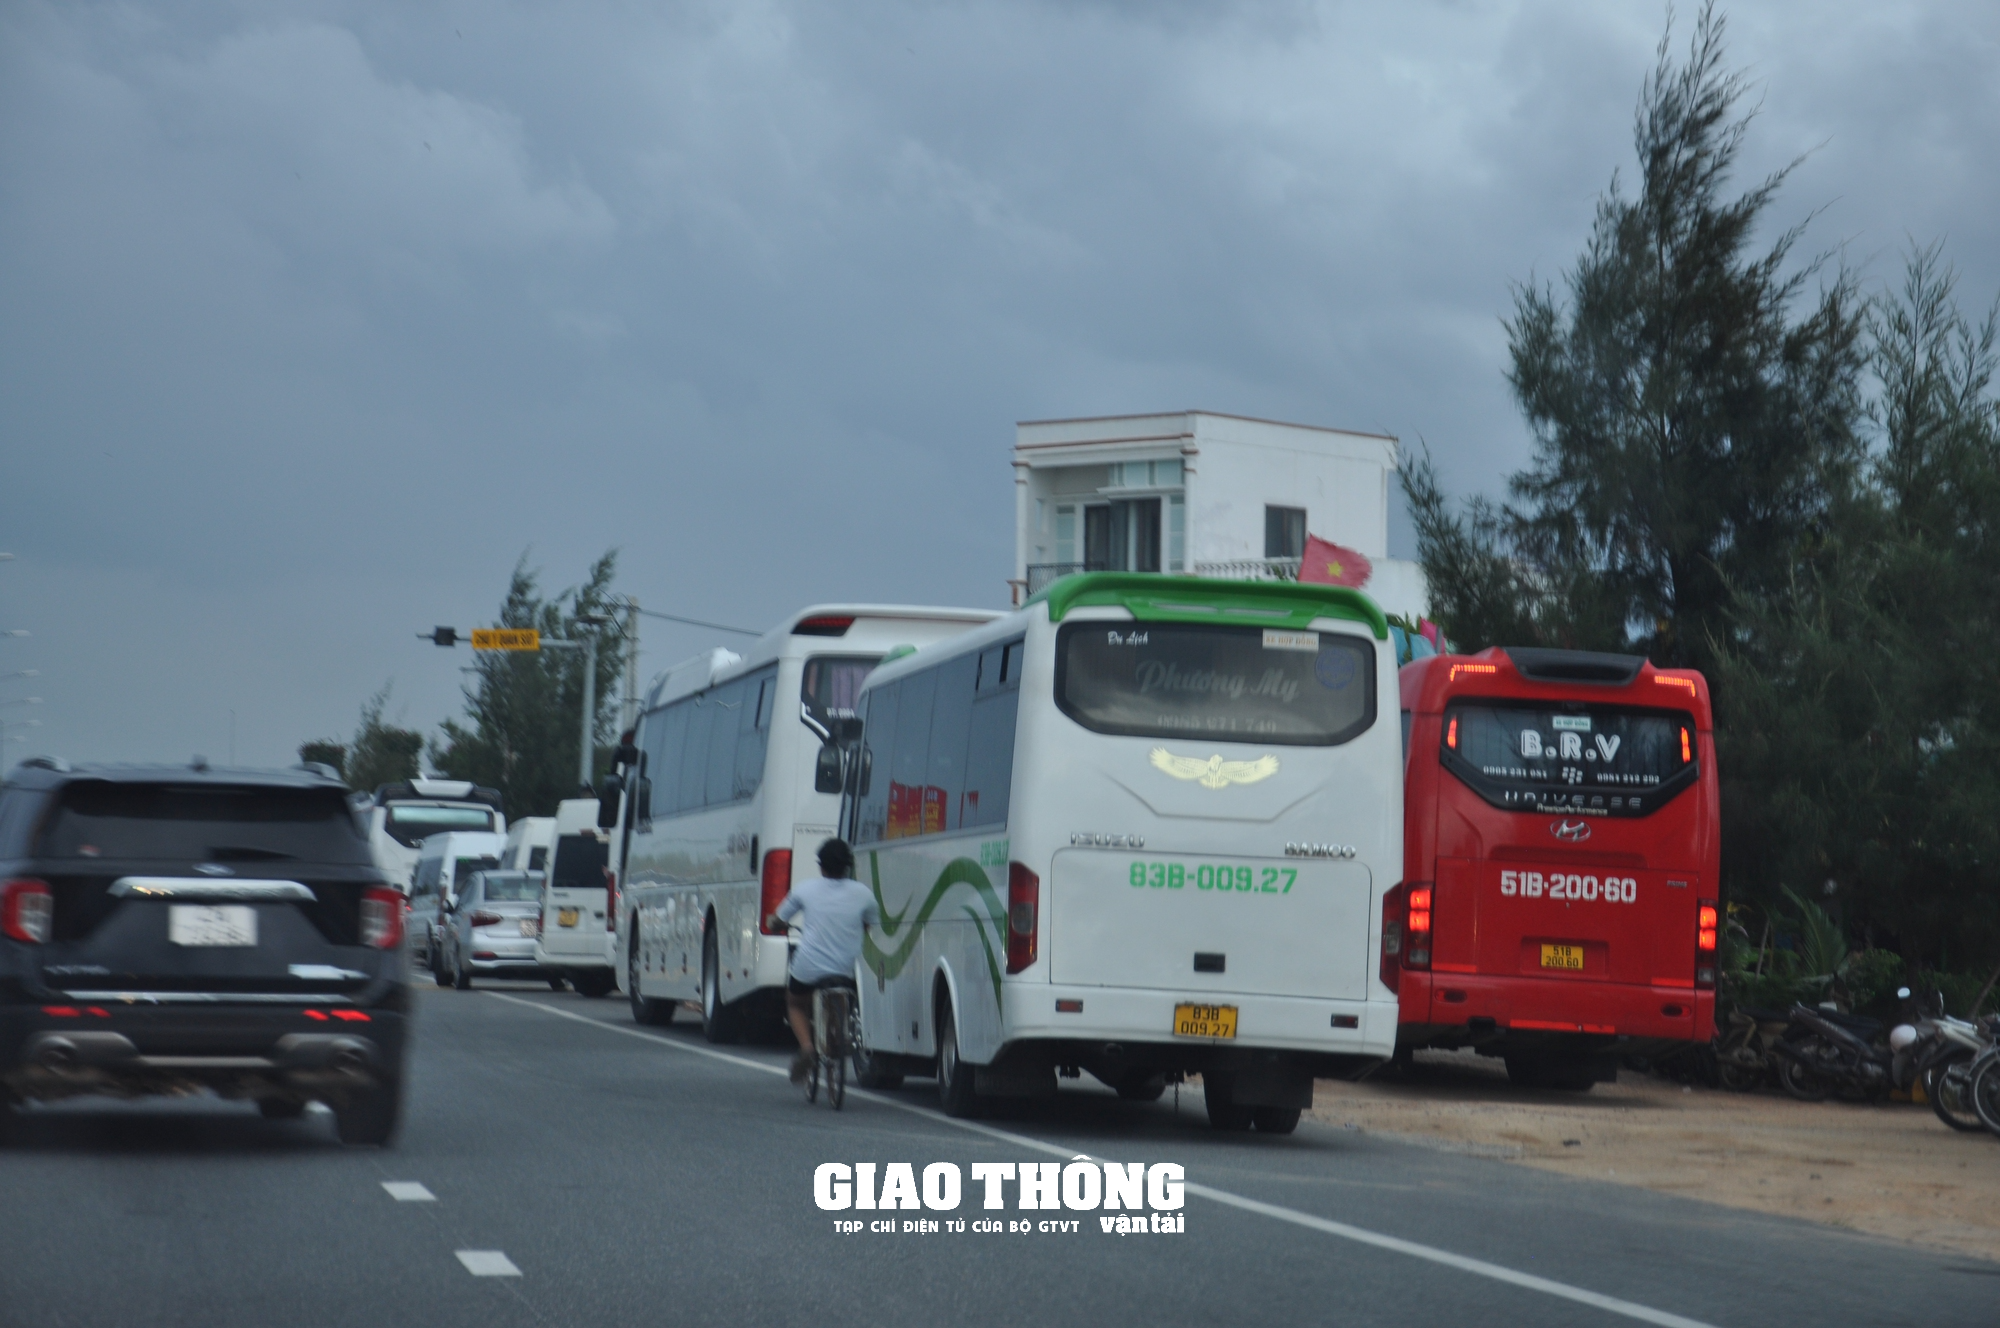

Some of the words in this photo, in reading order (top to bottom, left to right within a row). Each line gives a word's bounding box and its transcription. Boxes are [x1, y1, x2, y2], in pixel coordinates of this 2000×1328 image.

[1520, 729, 1621, 762] B.R.V
[1070, 831, 1145, 848] ISUZU
[1284, 841, 1356, 859] SAMCO
[1128, 860, 1298, 894] 83B-009.27
[1552, 945, 1572, 957] 51B
[1546, 955, 1579, 968] 200.60
[1192, 1007, 1220, 1022] 83B
[1180, 1021, 1230, 1038] 009.27
